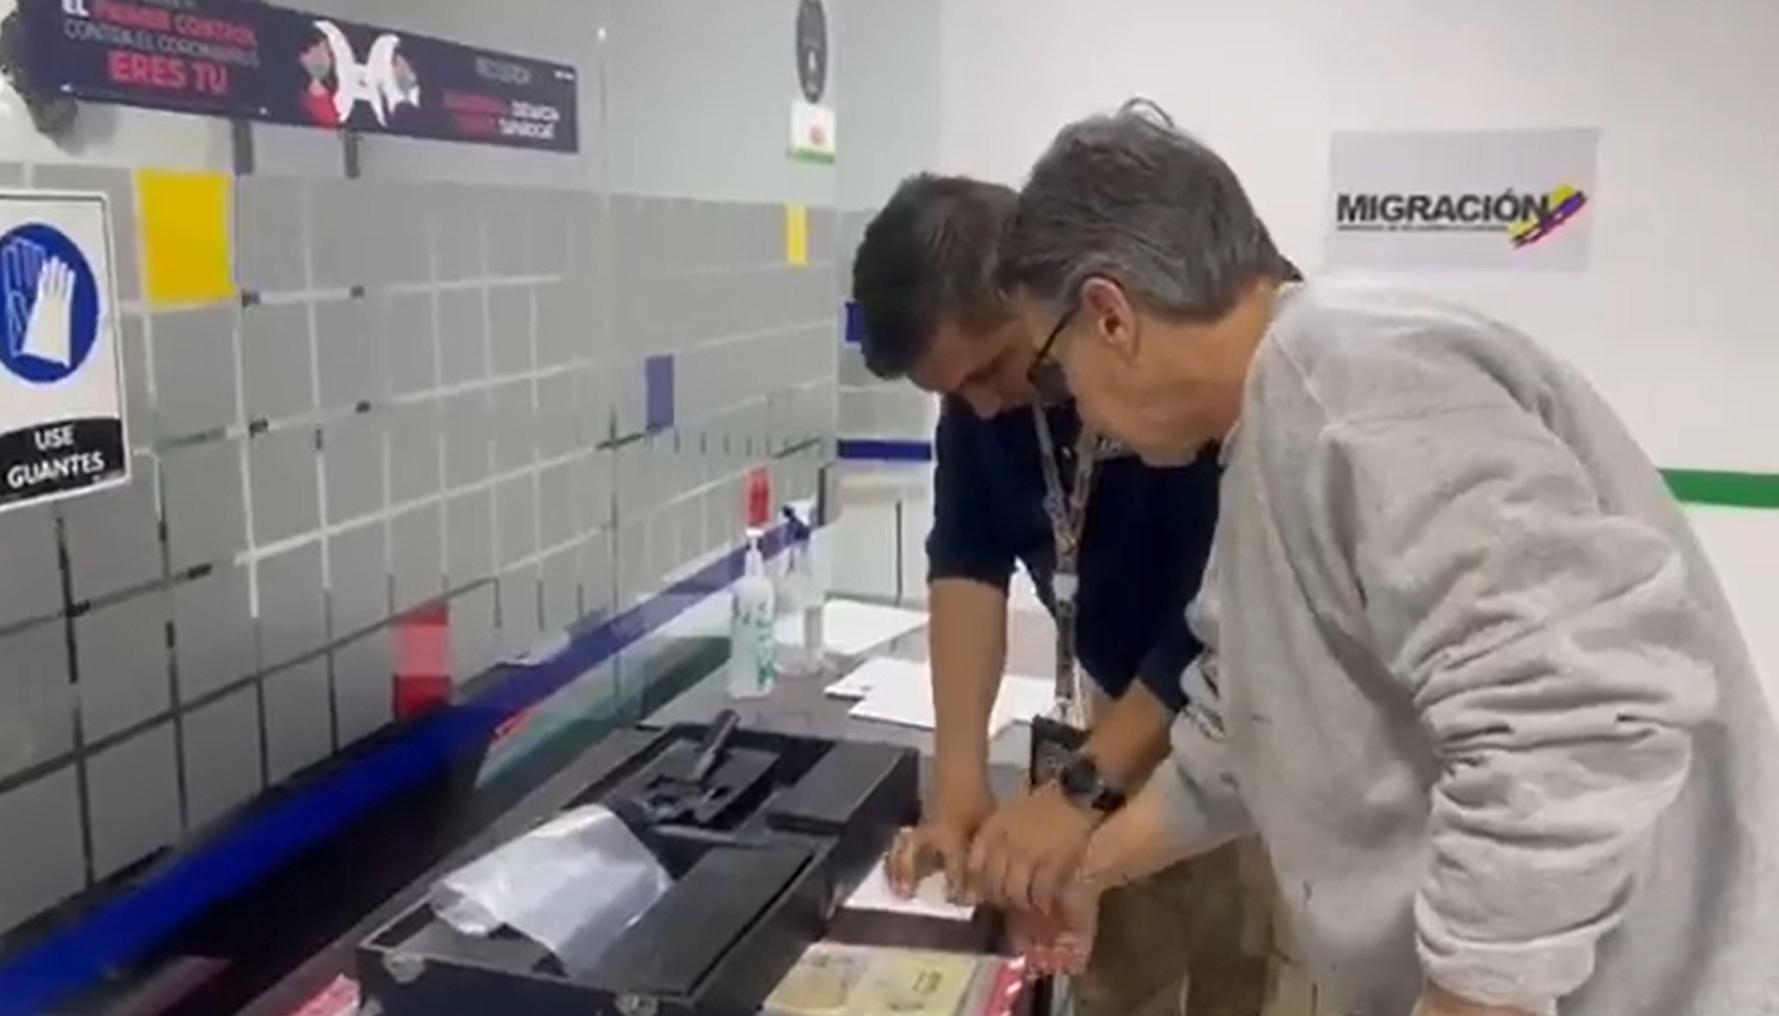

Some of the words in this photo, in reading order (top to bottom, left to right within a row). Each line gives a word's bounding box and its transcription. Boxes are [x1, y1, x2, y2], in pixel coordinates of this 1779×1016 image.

[109, 50, 187, 89] ERES
[1336, 187, 1550, 223] MIGRACIÓN
[34, 424, 75, 450] USE
[7, 451, 106, 489] GUANTES
